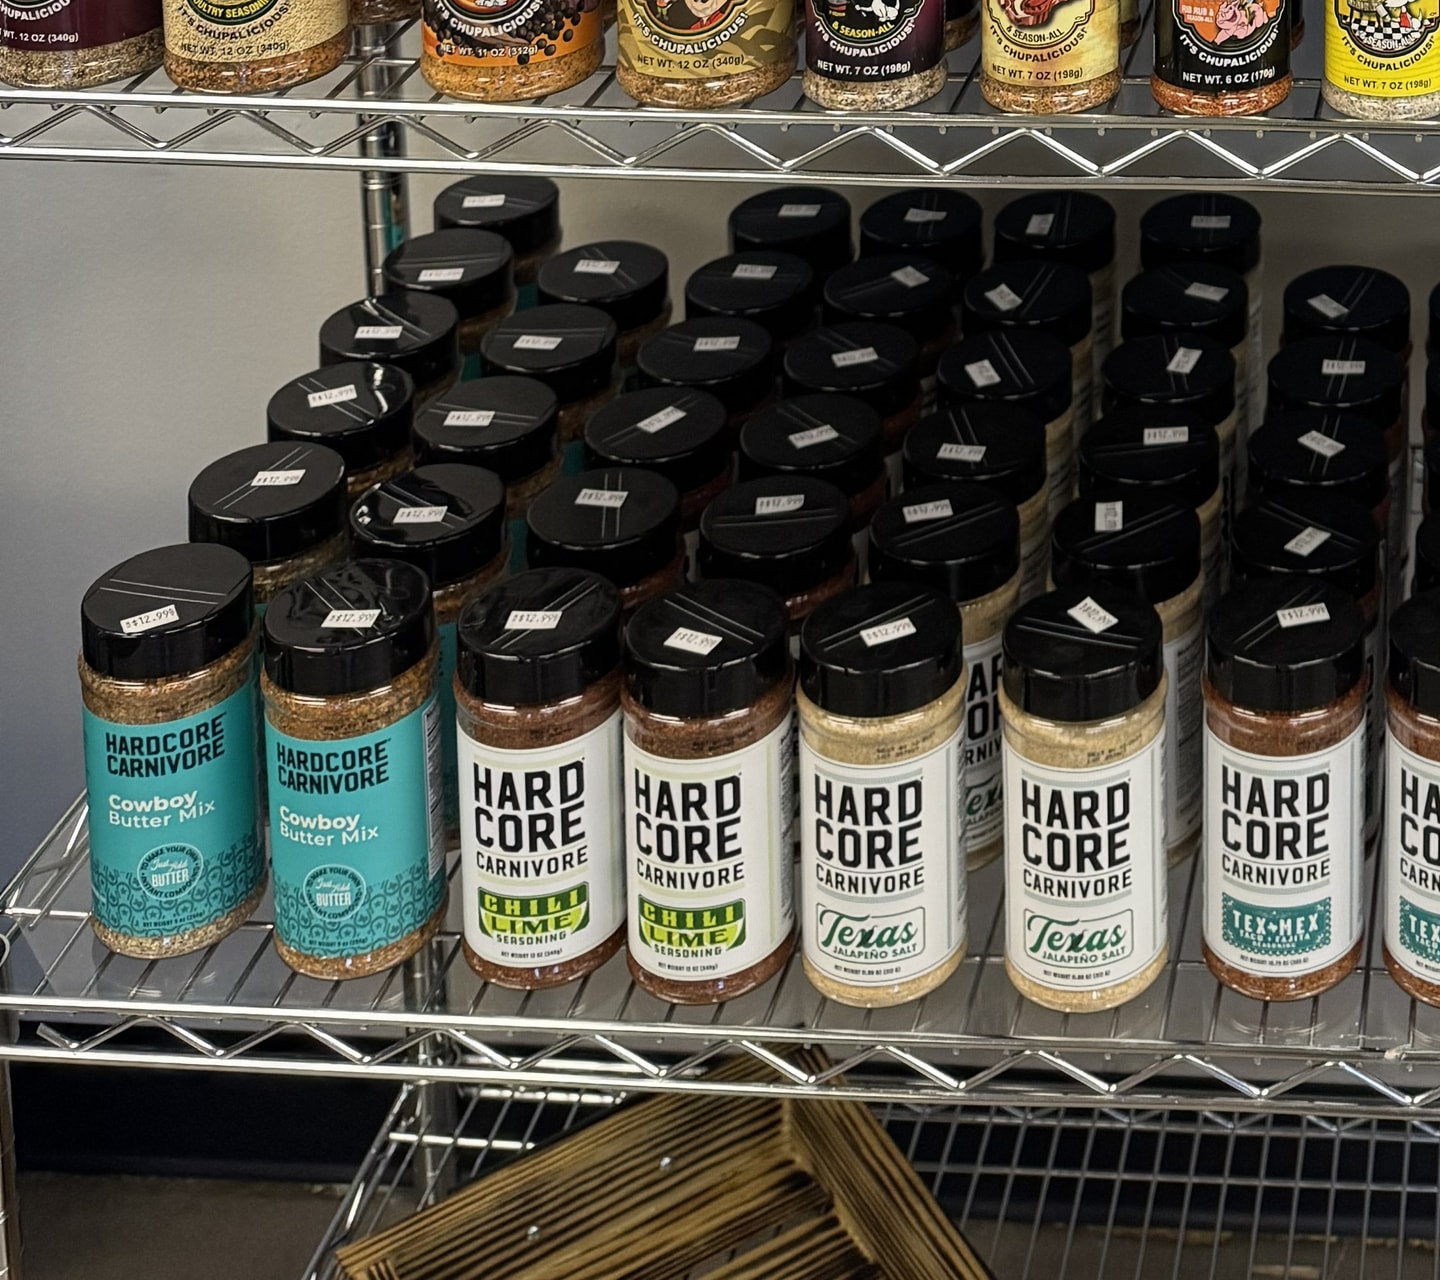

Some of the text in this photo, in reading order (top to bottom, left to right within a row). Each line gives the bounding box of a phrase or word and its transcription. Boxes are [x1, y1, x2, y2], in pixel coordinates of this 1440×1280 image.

[105, 714, 226, 757] HARDCORE
[106, 736, 226, 778] CARNIVORE
[108, 789, 199, 814] Cowboy
[472, 759, 585, 812] HARD
[108, 800, 216, 829] Butter Mix
[473, 800, 587, 854] CORE
[476, 844, 589, 879] CARNIVORE
[483, 889, 579, 917] CHILI
[489, 914, 574, 935] LIME
[496, 931, 567, 946] SEASONING
[818, 907, 919, 950] Texas
[833, 942, 918, 961] JALAPEÑO SALT
